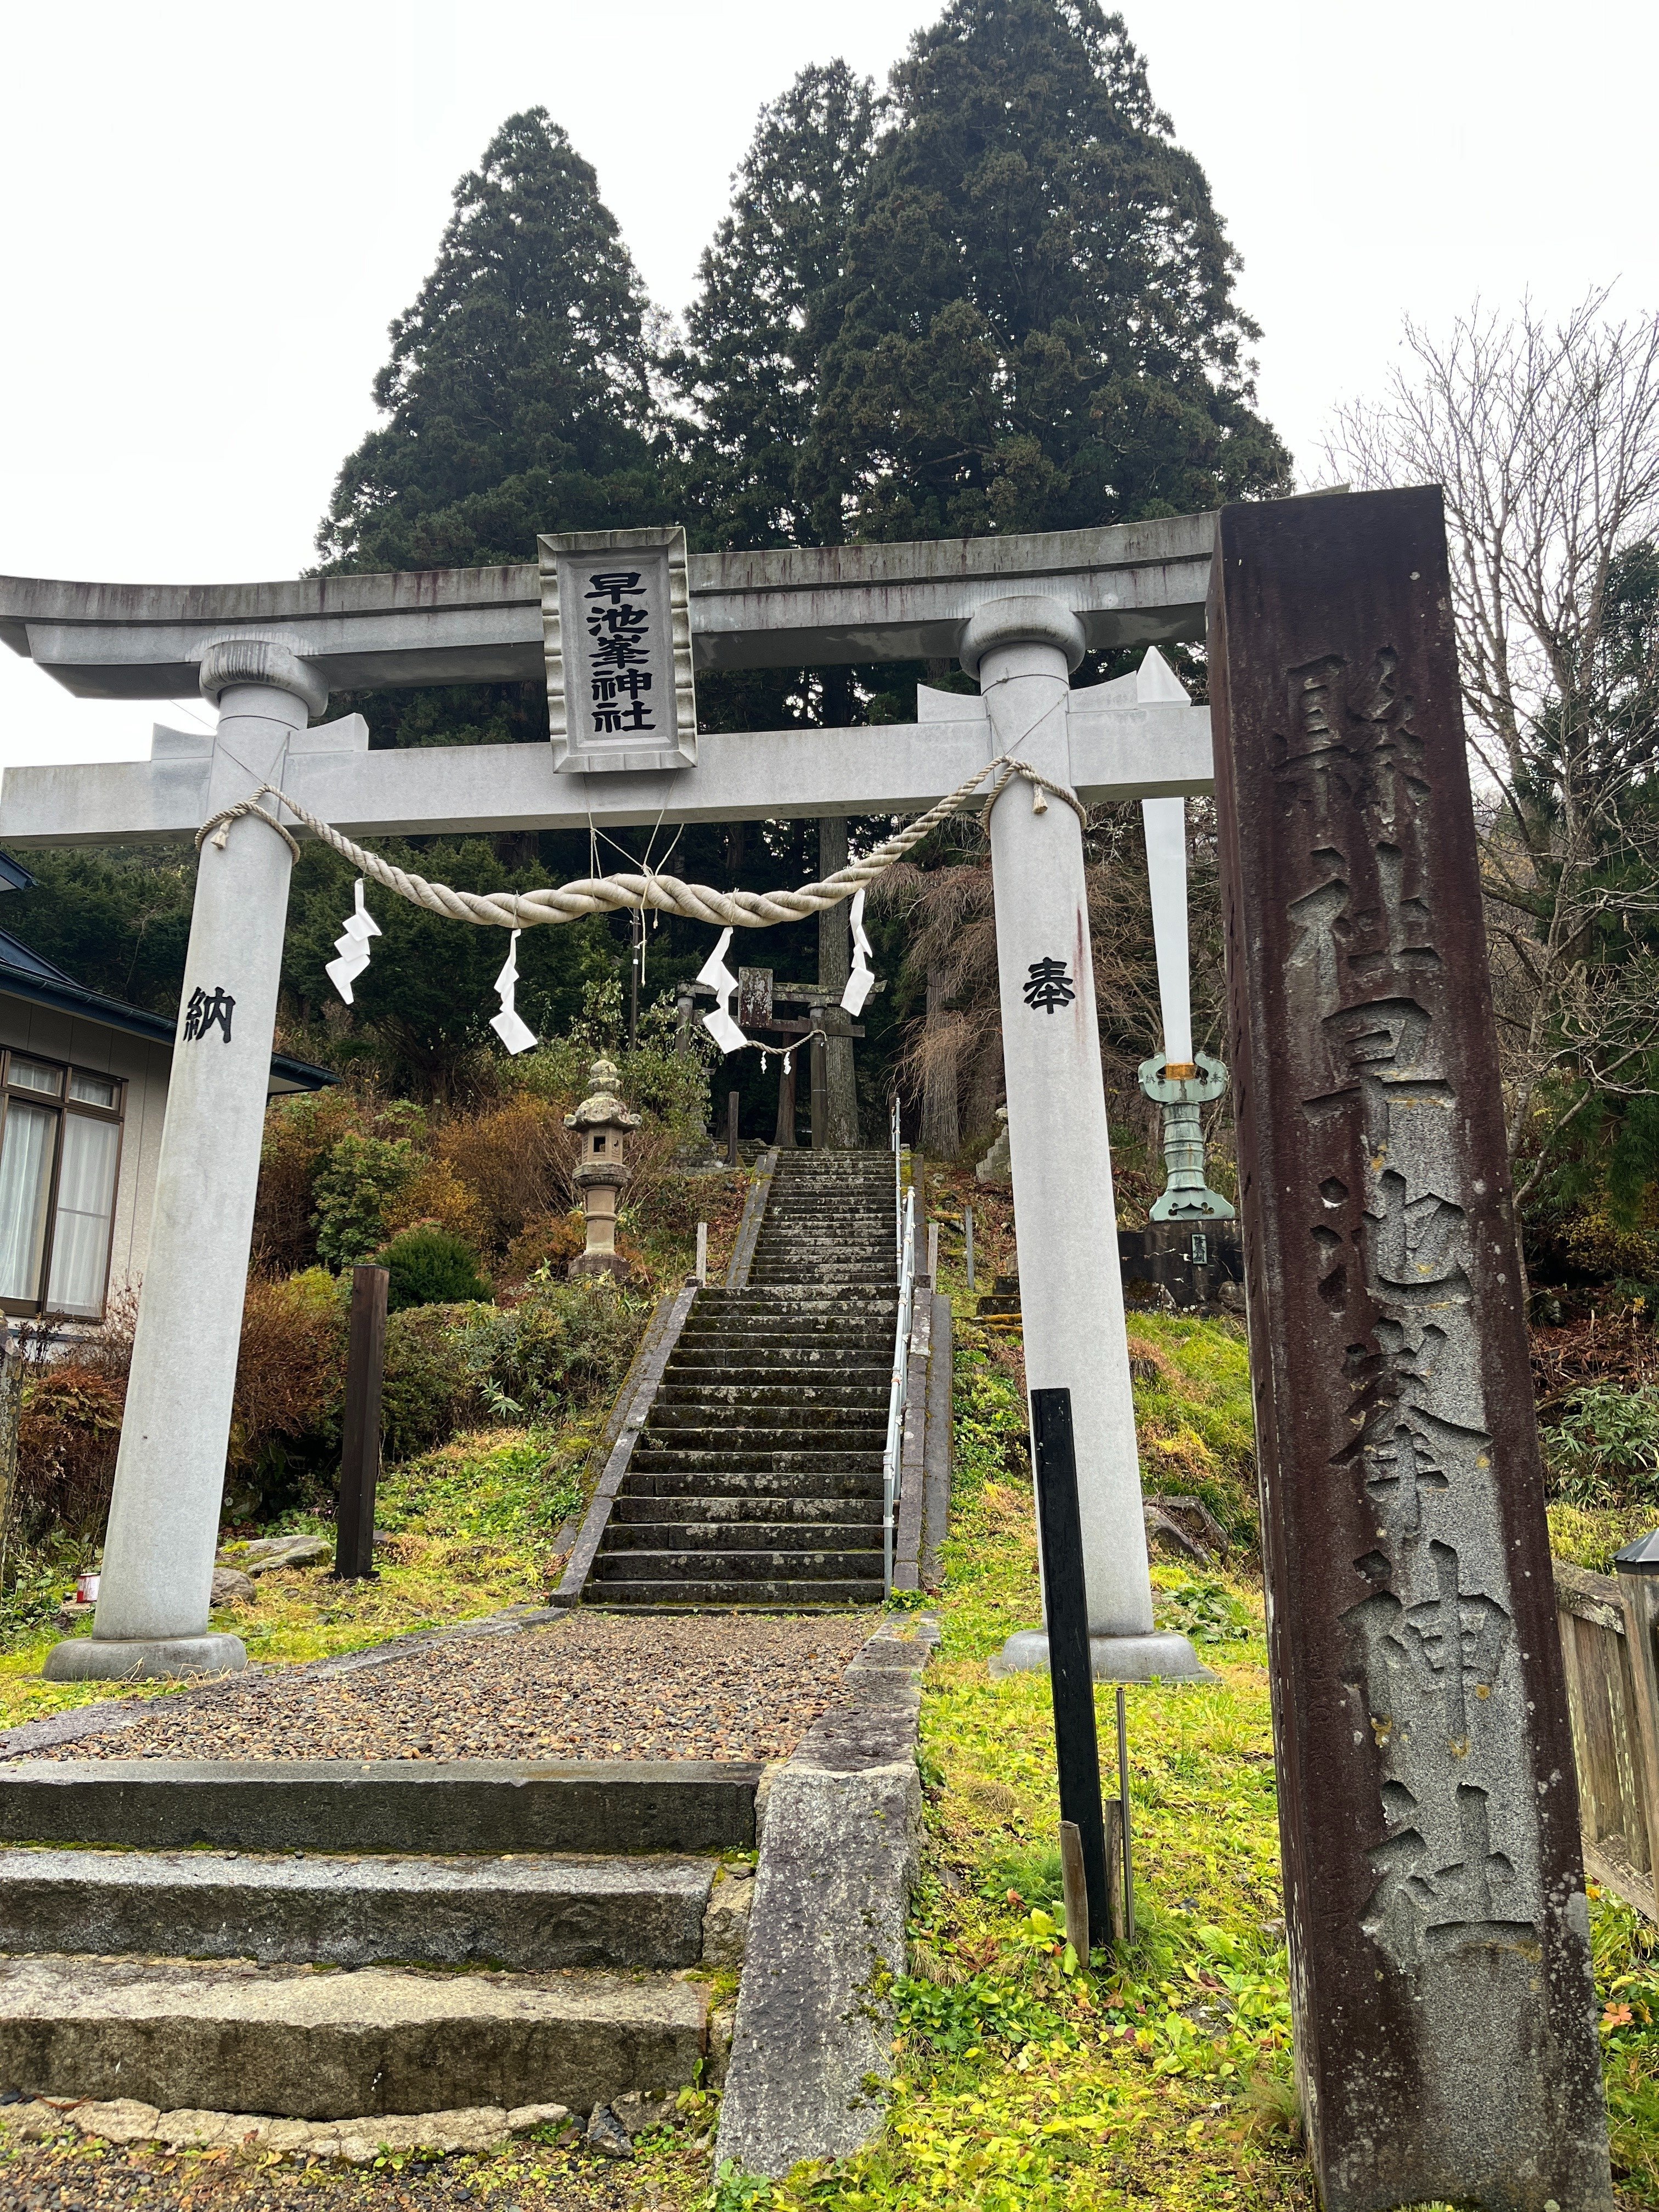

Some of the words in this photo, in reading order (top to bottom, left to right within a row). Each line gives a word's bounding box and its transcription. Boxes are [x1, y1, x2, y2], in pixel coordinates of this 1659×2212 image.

[584, 572, 656, 733] 早池峯神社
[1023, 956, 1076, 1014] 奉
[183, 986, 236, 1044] 納
